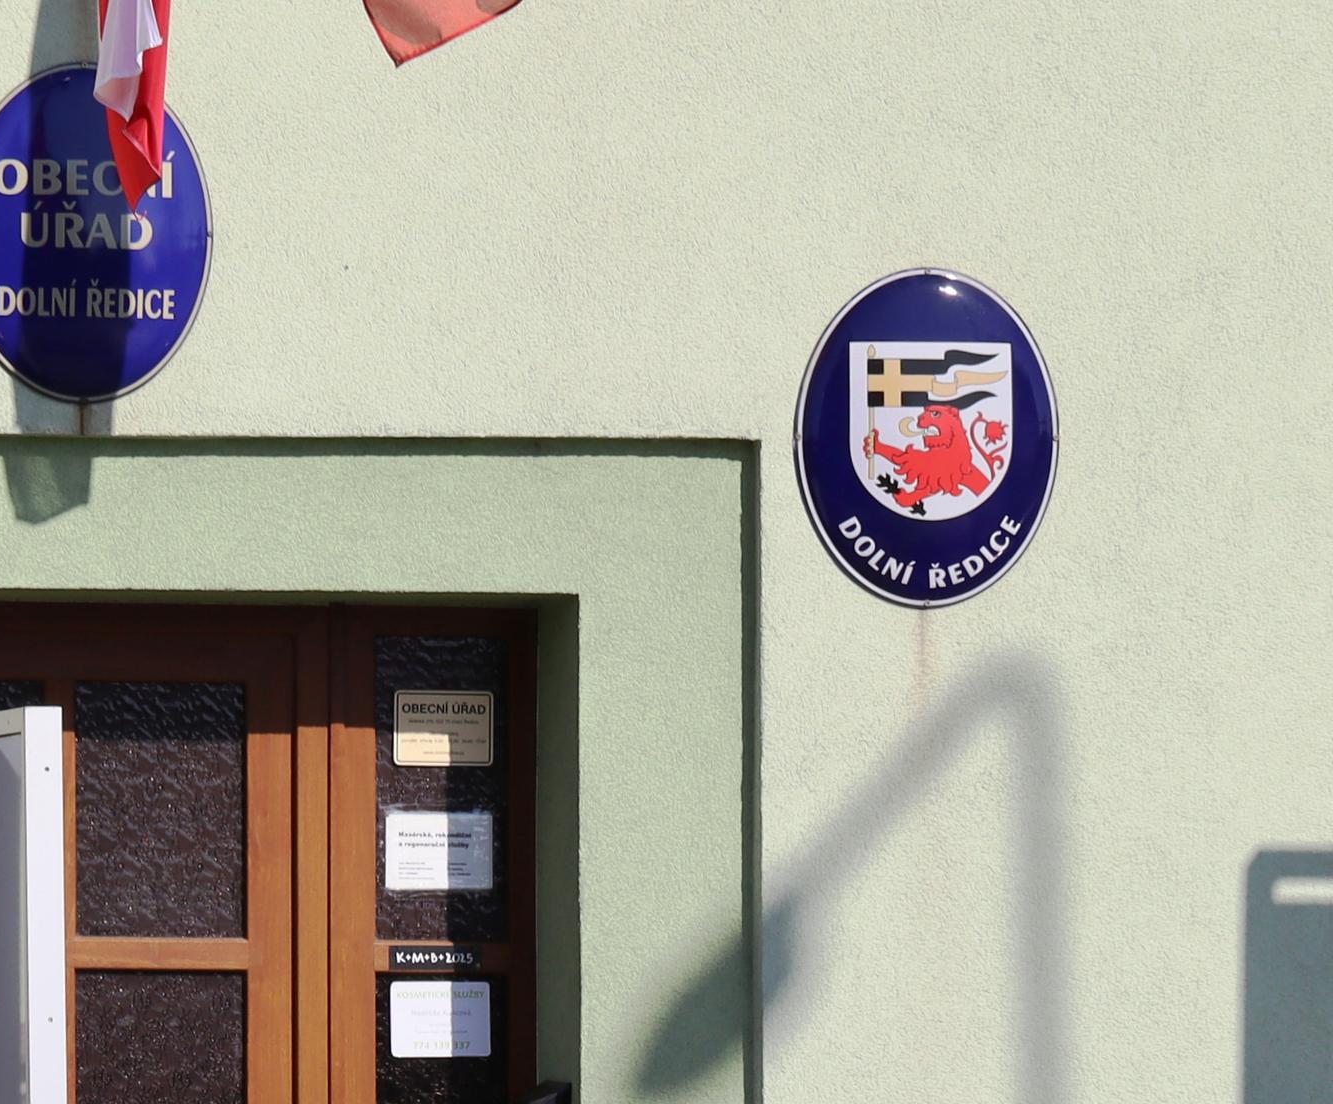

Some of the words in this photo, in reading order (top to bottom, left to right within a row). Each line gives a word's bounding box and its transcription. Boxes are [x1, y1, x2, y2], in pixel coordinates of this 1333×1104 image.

[20, 201, 153, 250] ÚŘAD
[86, 279, 175, 320] ŘEDICE
[838, 515, 916, 586] DOLNÍ
[928, 514, 1022, 589] ŘEDICE
[402, 702, 448, 714] OBECNÍ
[452, 701, 486, 715] ÚŘAD
[452, 989, 485, 999] SLUŽBY
